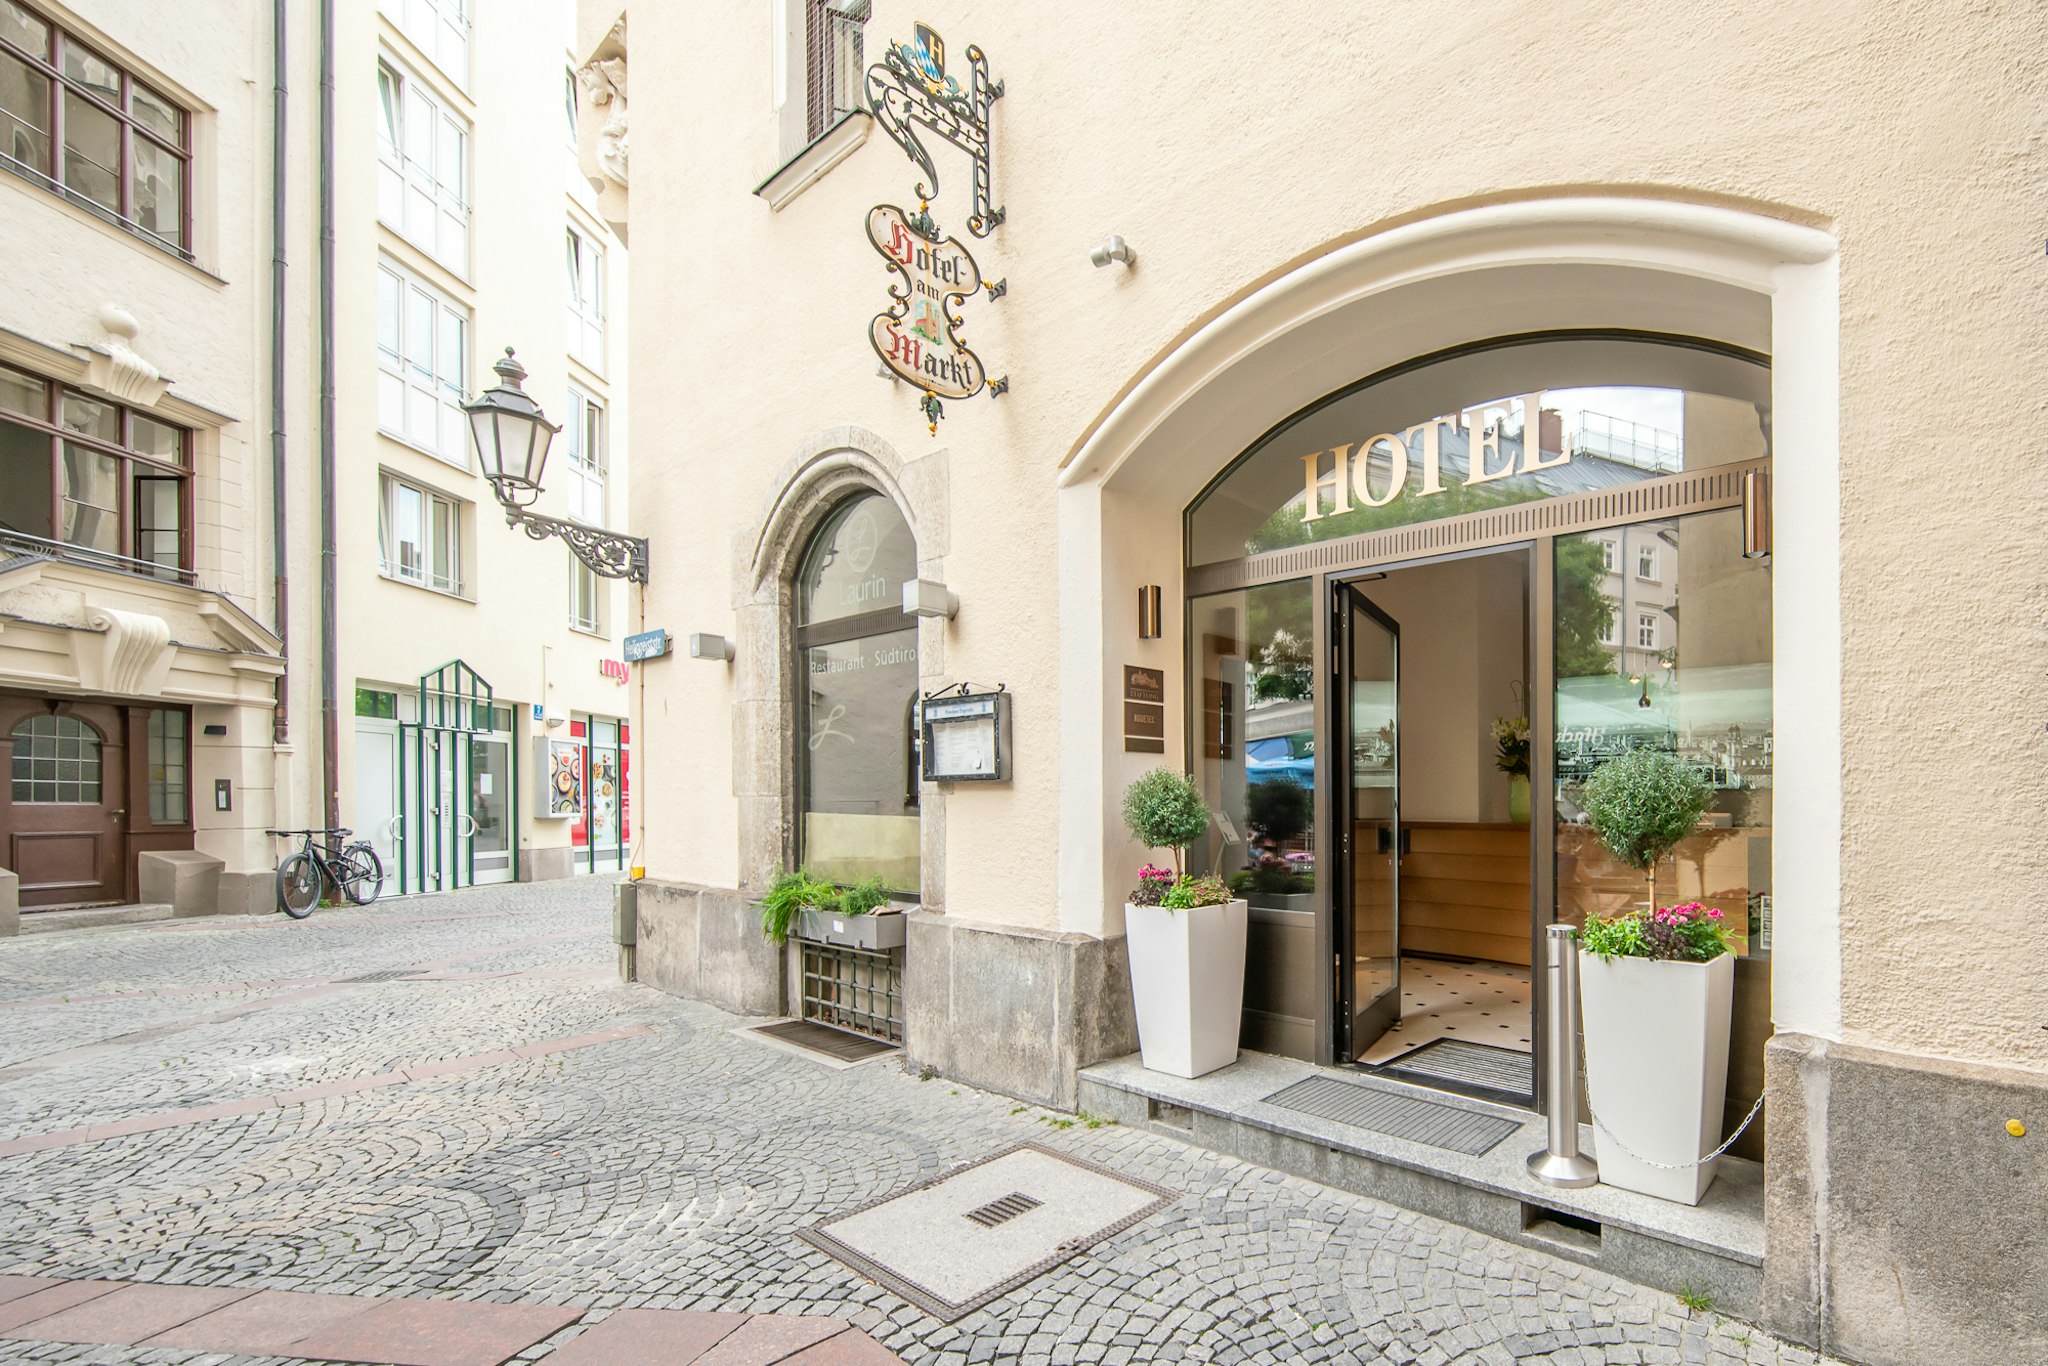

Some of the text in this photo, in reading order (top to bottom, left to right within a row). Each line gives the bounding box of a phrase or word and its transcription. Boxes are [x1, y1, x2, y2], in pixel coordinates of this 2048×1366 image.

[916, 278, 940, 302] am
[885, 324, 974, 391] Markt
[1299, 389, 1573, 524] HOTEL
[839, 573, 886, 605] Laurin
[810, 655, 865, 676] Restaurant
